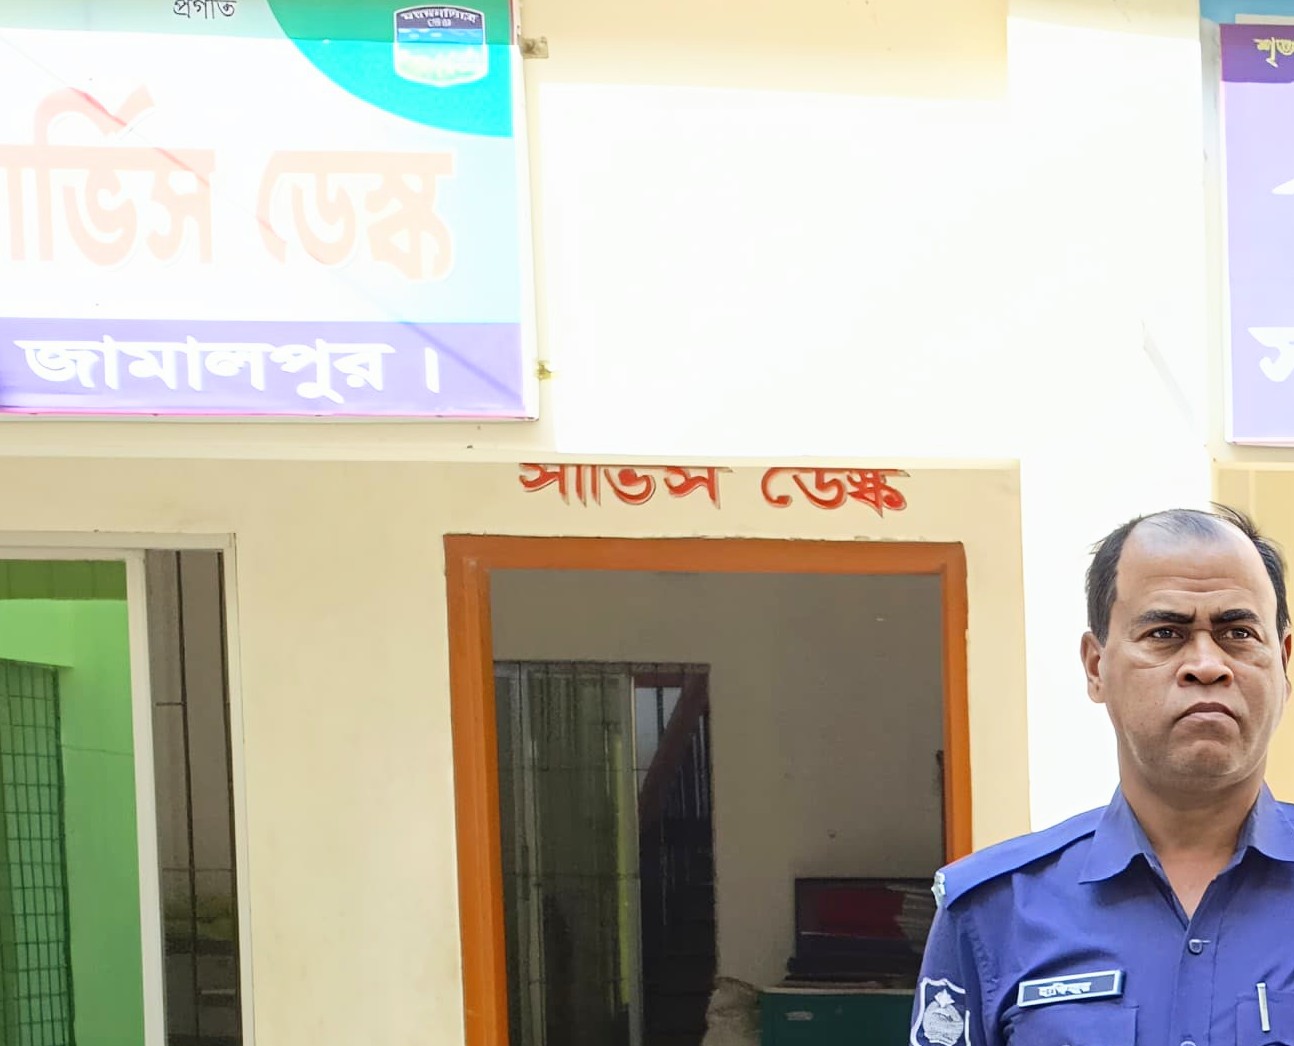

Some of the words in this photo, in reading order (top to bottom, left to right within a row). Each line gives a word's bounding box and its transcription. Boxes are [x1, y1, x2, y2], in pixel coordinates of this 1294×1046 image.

[0, 84, 216, 267] ার্ভিস
[257, 150, 456, 281] ডেস্ক
[14, 335, 397, 403] জামালপুর
[761, 466, 911, 518] ডেস্ক
